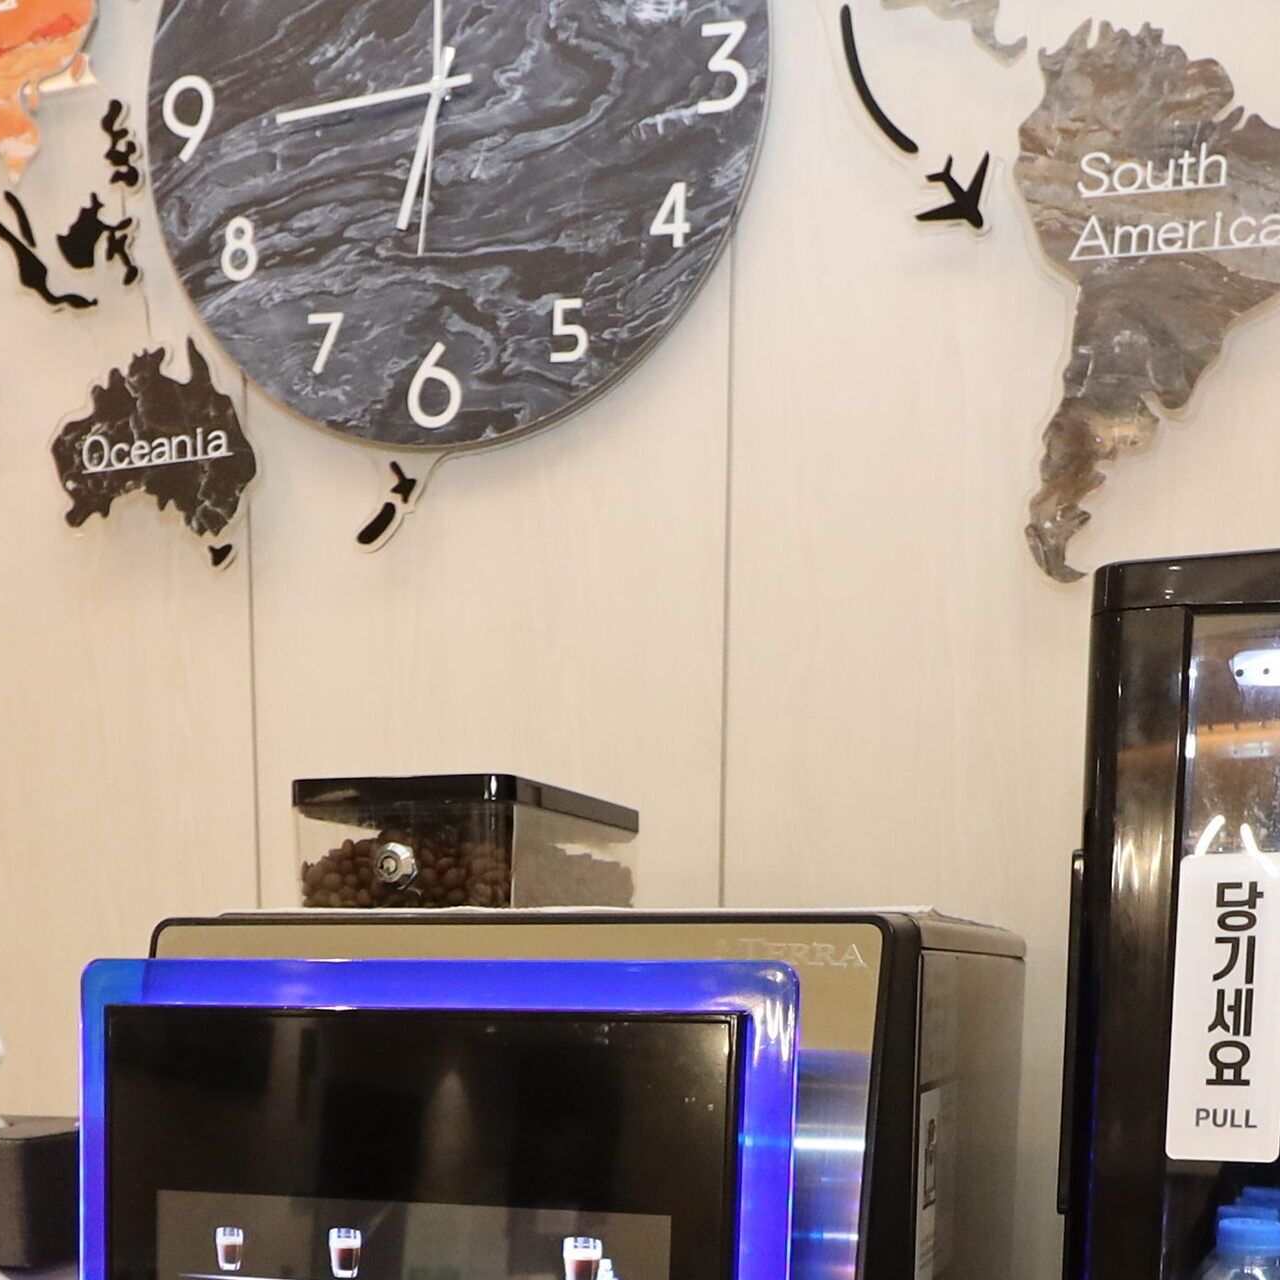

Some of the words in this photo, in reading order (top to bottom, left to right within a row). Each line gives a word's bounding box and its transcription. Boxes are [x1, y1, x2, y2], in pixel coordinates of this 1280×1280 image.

[697, 20, 750, 115] 3
[162, 75, 215, 162] 9
[1076, 141, 1228, 197] South
[650, 182, 692, 248] 4
[221, 216, 259, 281] 8
[307, 312, 345, 374] 7
[549, 298, 590, 363] 5
[406, 341, 463, 429] 6
[82, 427, 232, 473] Oceania
[1206, 880, 1265, 1087] 당기세요
[1195, 1108, 1258, 1129] PULL
